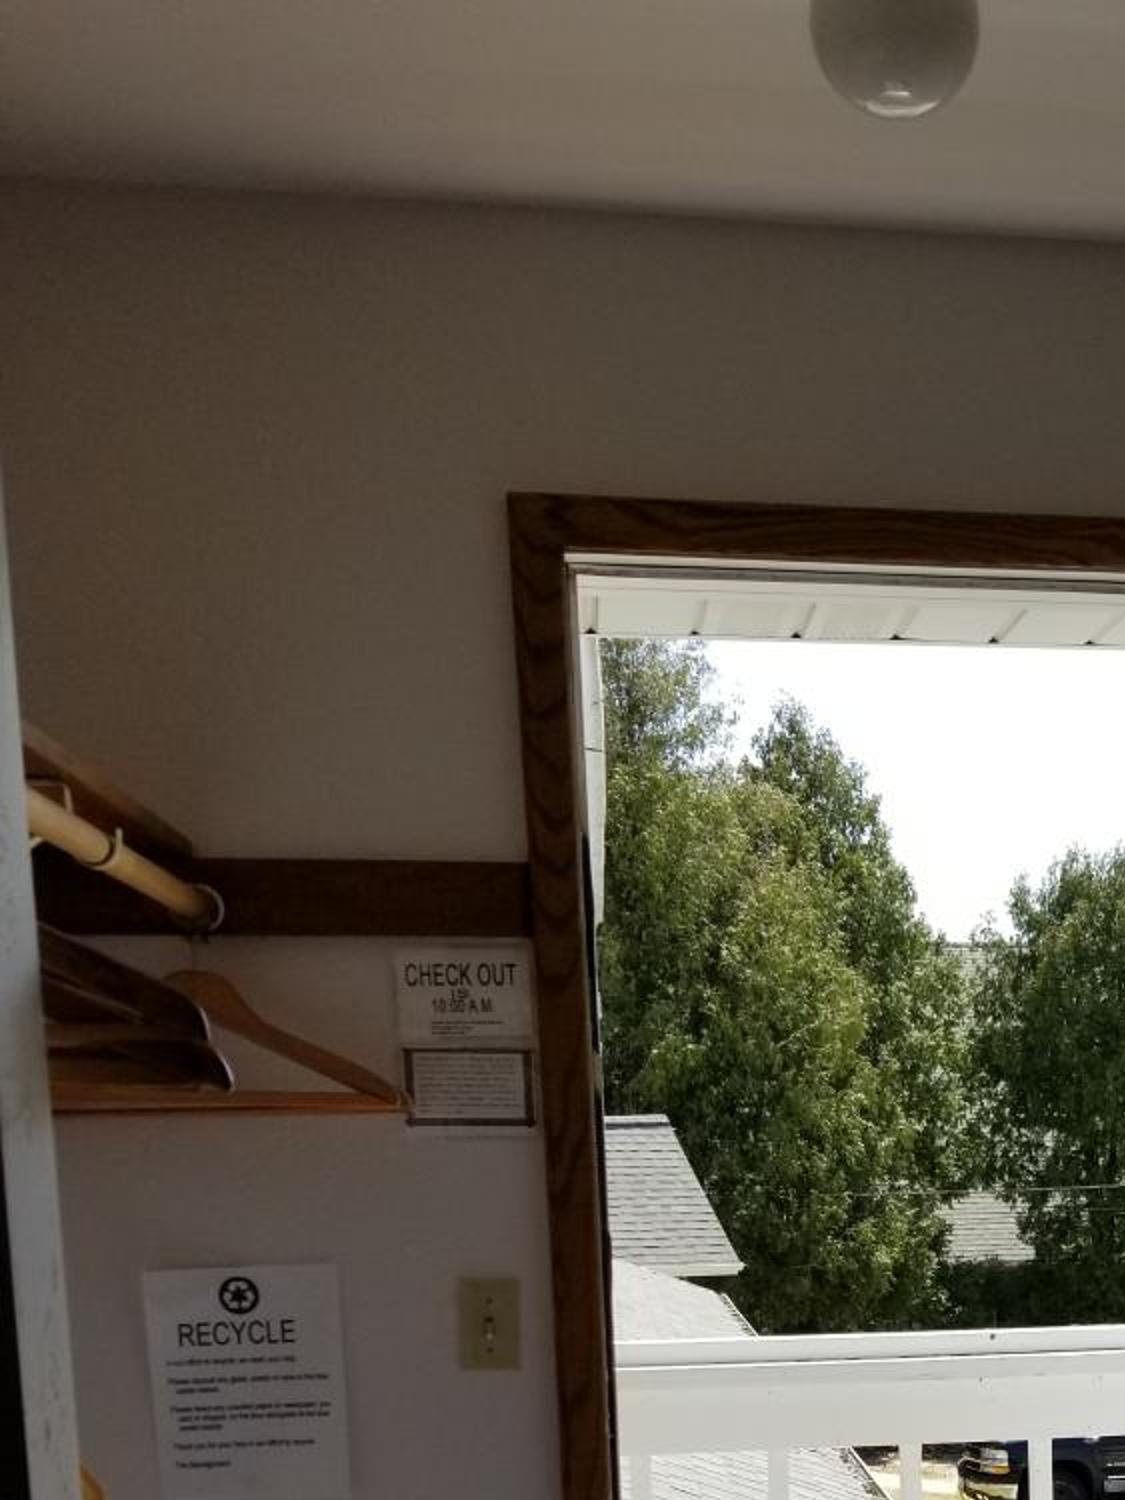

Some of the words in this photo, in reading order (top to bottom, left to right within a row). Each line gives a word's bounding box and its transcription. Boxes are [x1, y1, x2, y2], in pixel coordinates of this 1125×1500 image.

[405, 964, 472, 986] CHECK
[477, 964, 517, 986] OUT
[178, 1319, 296, 1346] RECYCLE
